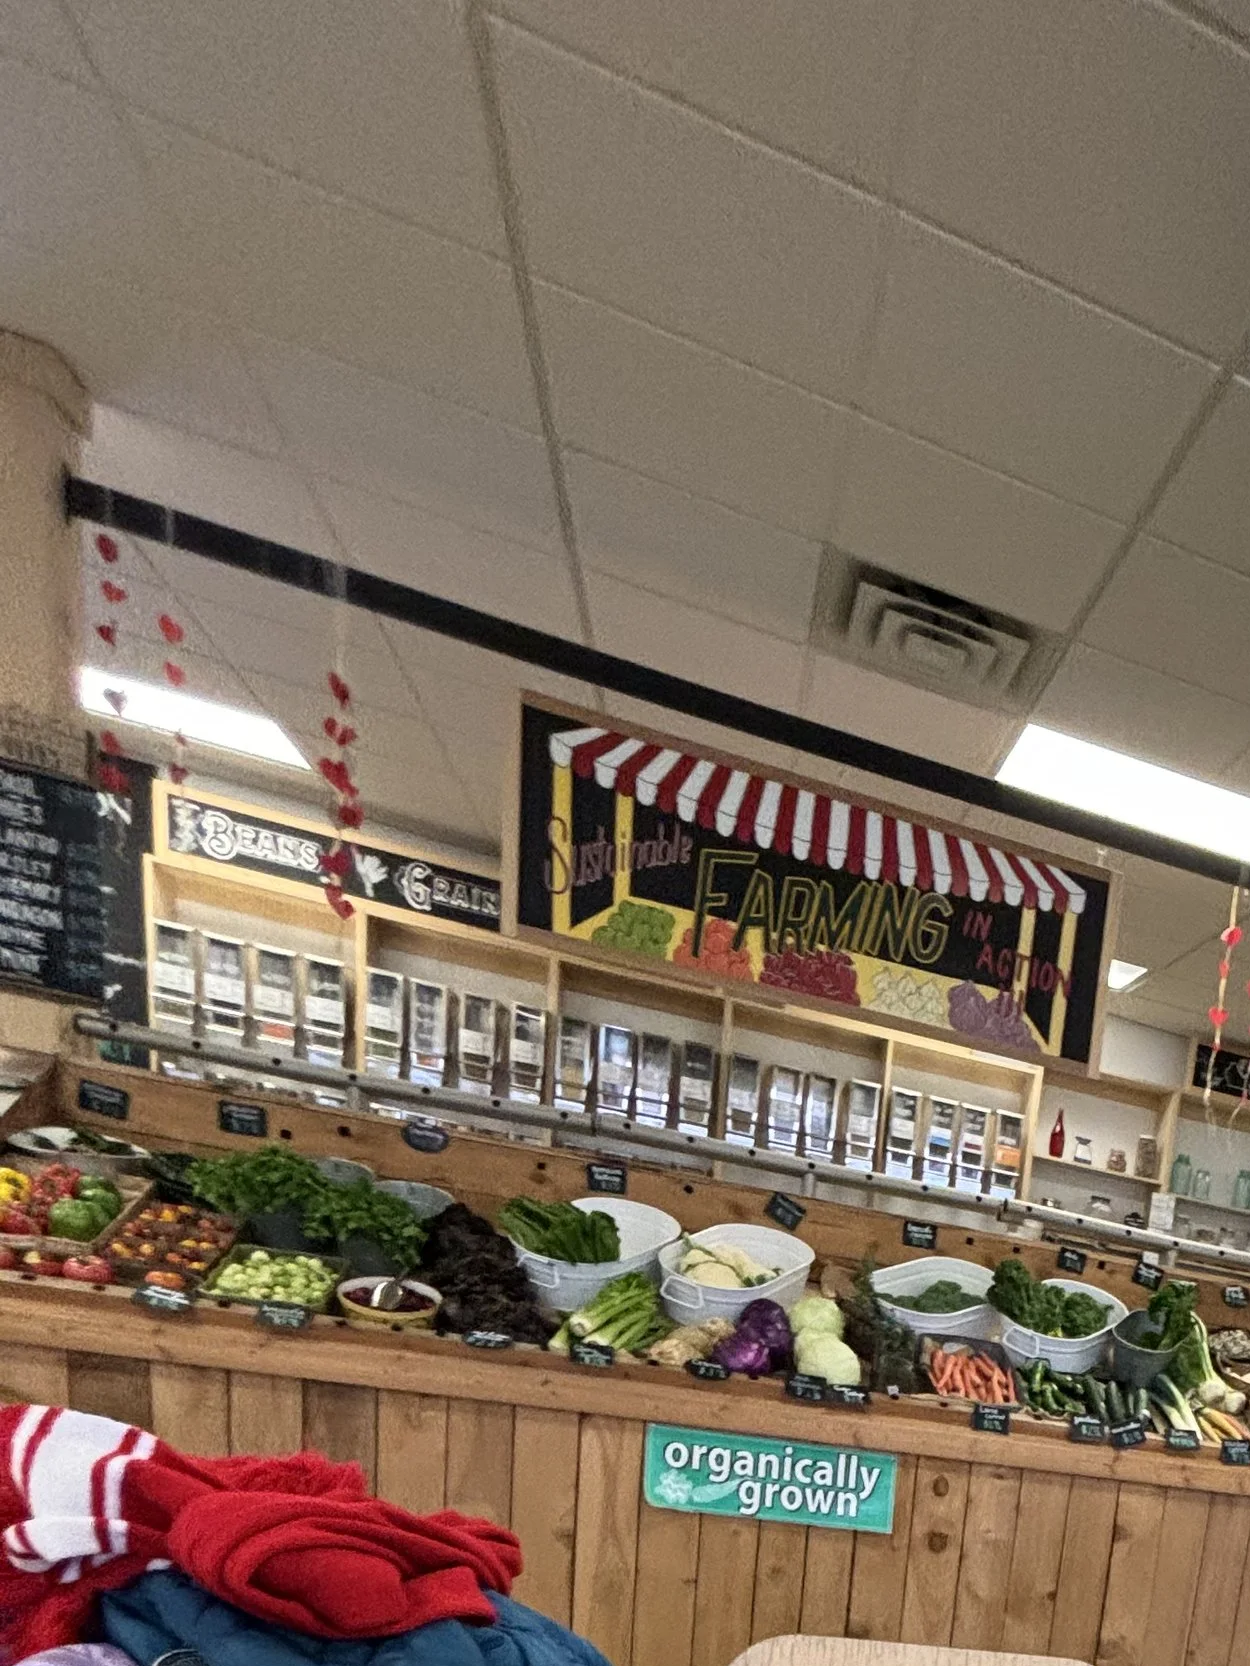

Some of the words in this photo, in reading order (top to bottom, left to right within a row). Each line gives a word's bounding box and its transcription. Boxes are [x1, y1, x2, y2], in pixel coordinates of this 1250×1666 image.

[690, 847, 954, 966] FARMING
[962, 910, 993, 940] IN
[975, 942, 1073, 998] ACTION
[663, 1440, 882, 1501] organically
[737, 1478, 860, 1518] grown
